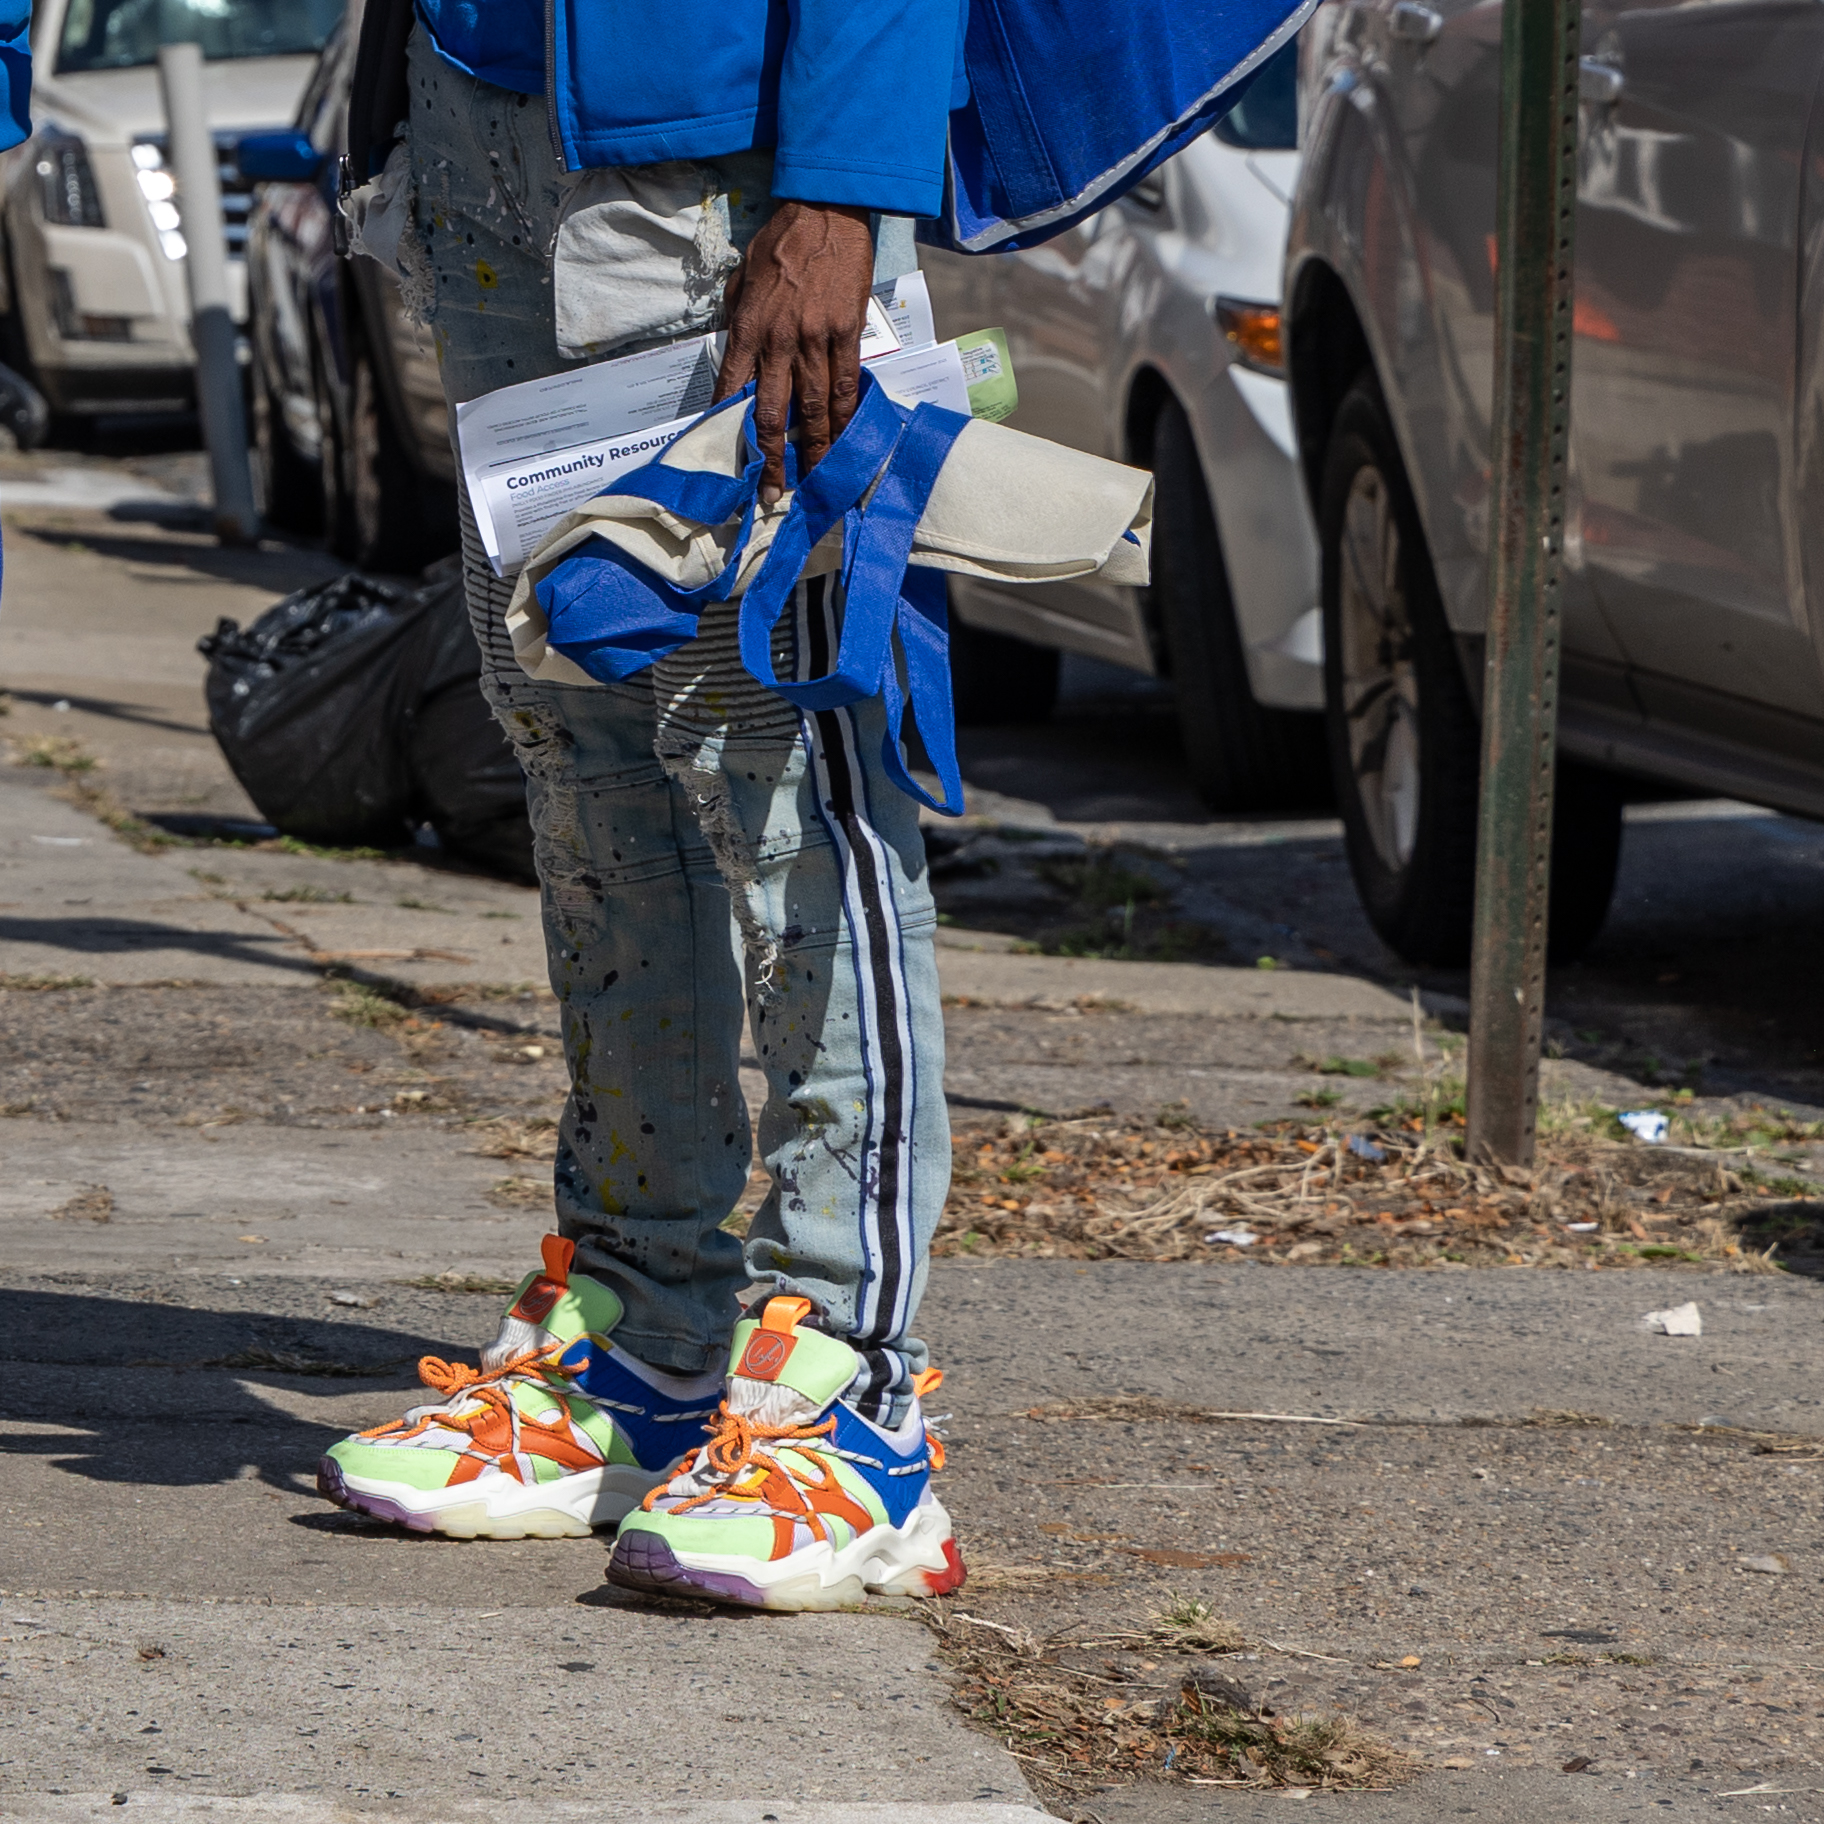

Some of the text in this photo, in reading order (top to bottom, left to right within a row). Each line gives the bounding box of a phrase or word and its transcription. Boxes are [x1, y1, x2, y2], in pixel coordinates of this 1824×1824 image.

[507, 454, 604, 490] Community
[510, 479, 570, 501] Food Access
